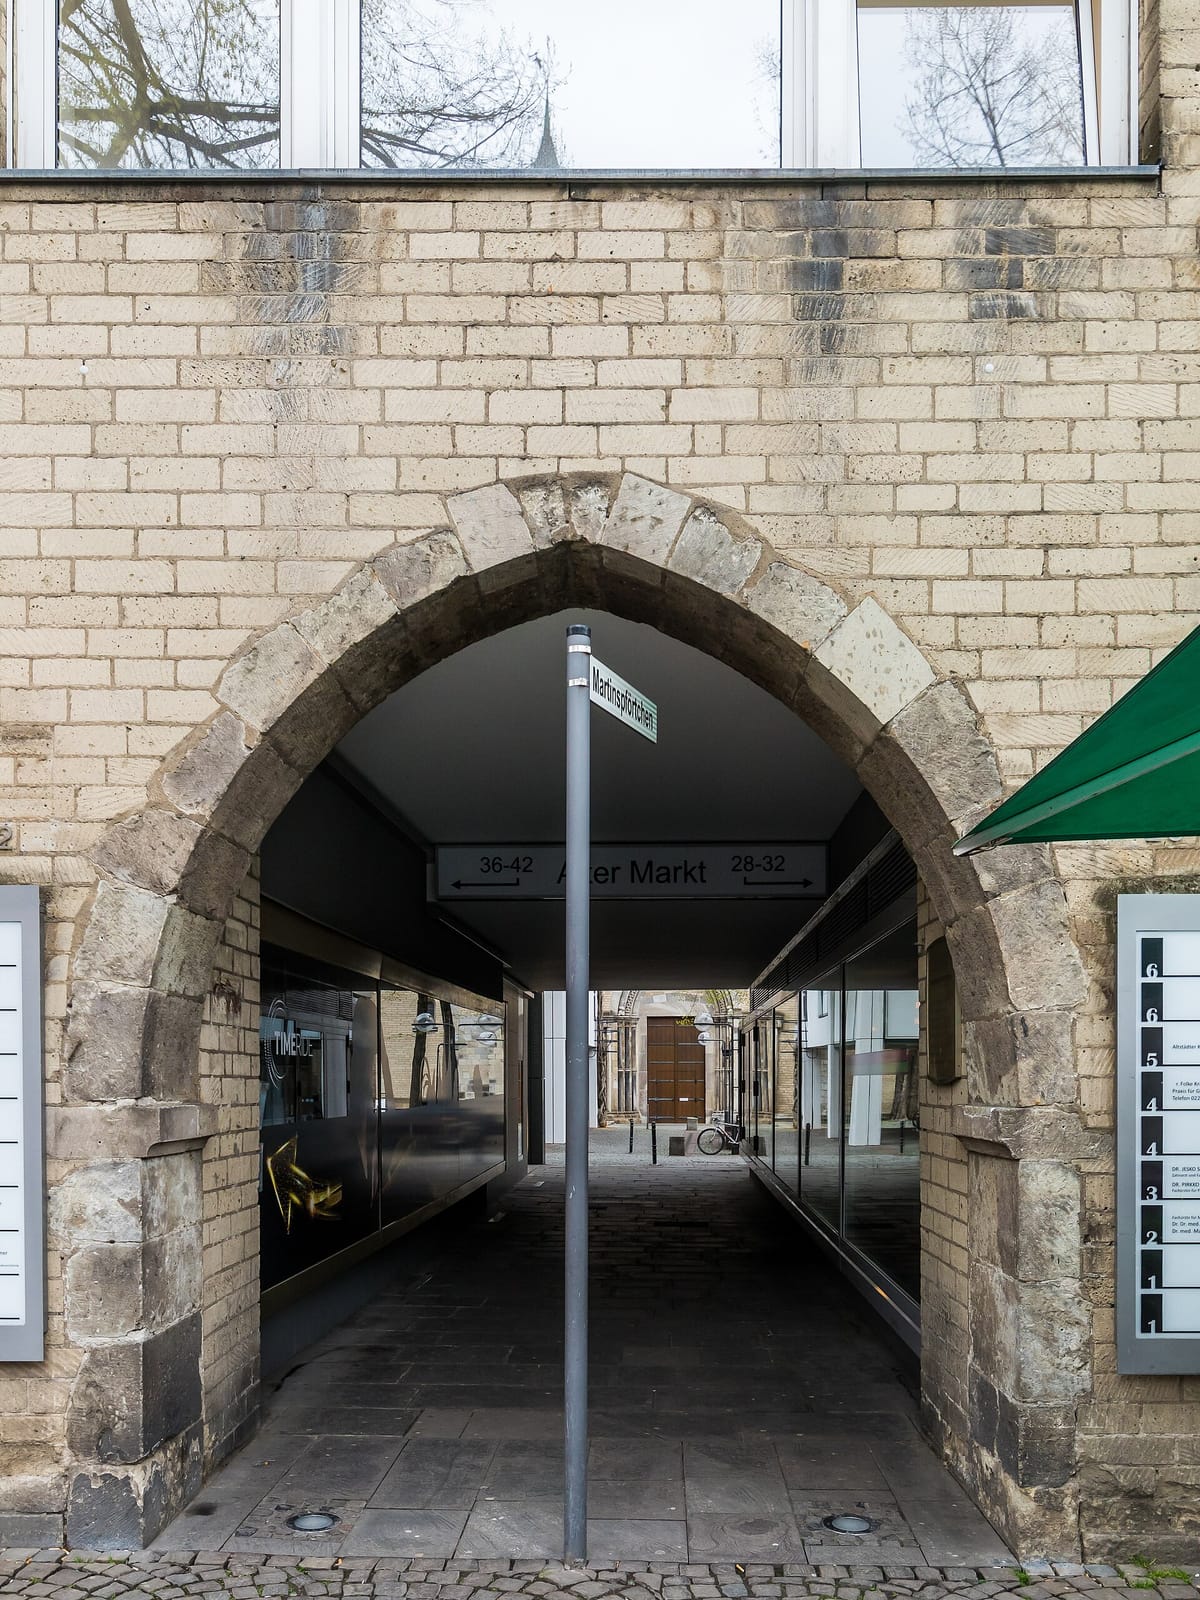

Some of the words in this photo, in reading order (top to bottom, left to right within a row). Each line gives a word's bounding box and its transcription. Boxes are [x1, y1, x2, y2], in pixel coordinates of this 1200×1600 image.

[592, 666, 653, 731] Martinspförtchen
[480, 856, 534, 873] 36-42
[731, 855, 785, 872] 28-32
[630, 859, 707, 884] Markt
[1146, 963, 1158, 977] 6
[1146, 1008, 1158, 1022] 6
[1146, 1053, 1158, 1067] 5
[1146, 1097, 1158, 1111] 4
[1146, 1142, 1158, 1156] 4
[1146, 1186, 1158, 1200] 3
[1146, 1231, 1158, 1245] 2
[1147, 1275, 1157, 1289] 1
[1147, 1320, 1157, 1333] 1
